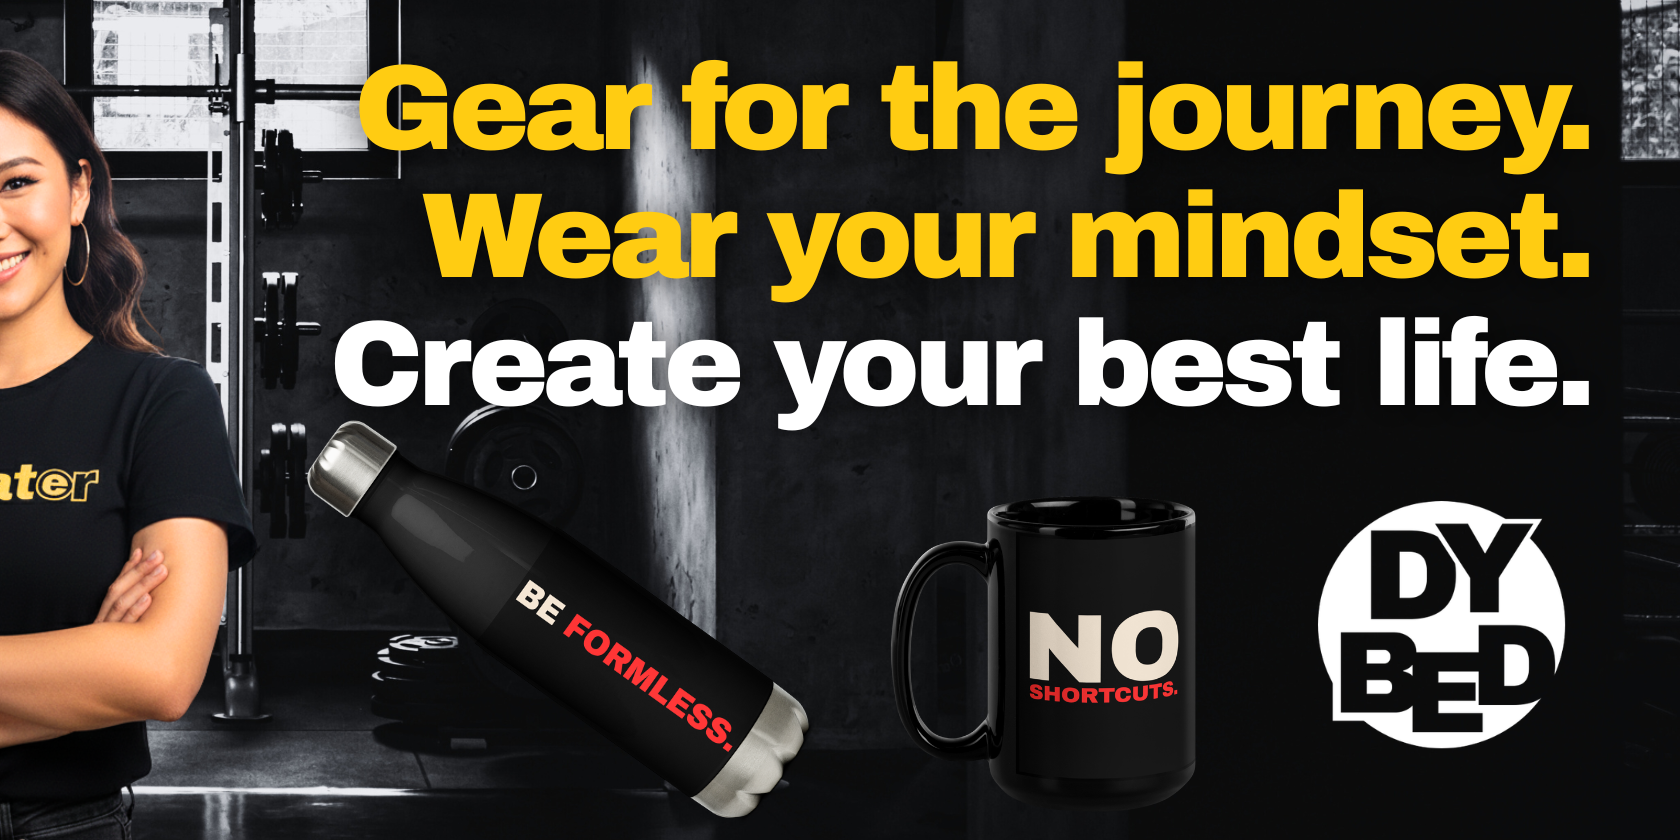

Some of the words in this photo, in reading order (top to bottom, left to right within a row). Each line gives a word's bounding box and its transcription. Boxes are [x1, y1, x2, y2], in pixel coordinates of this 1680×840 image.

[516, 580, 567, 625] BE
[563, 614, 733, 753] FORMLESS.
[1030, 610, 1179, 683] NO
[1029, 681, 1179, 704] SHORTCUTS.
